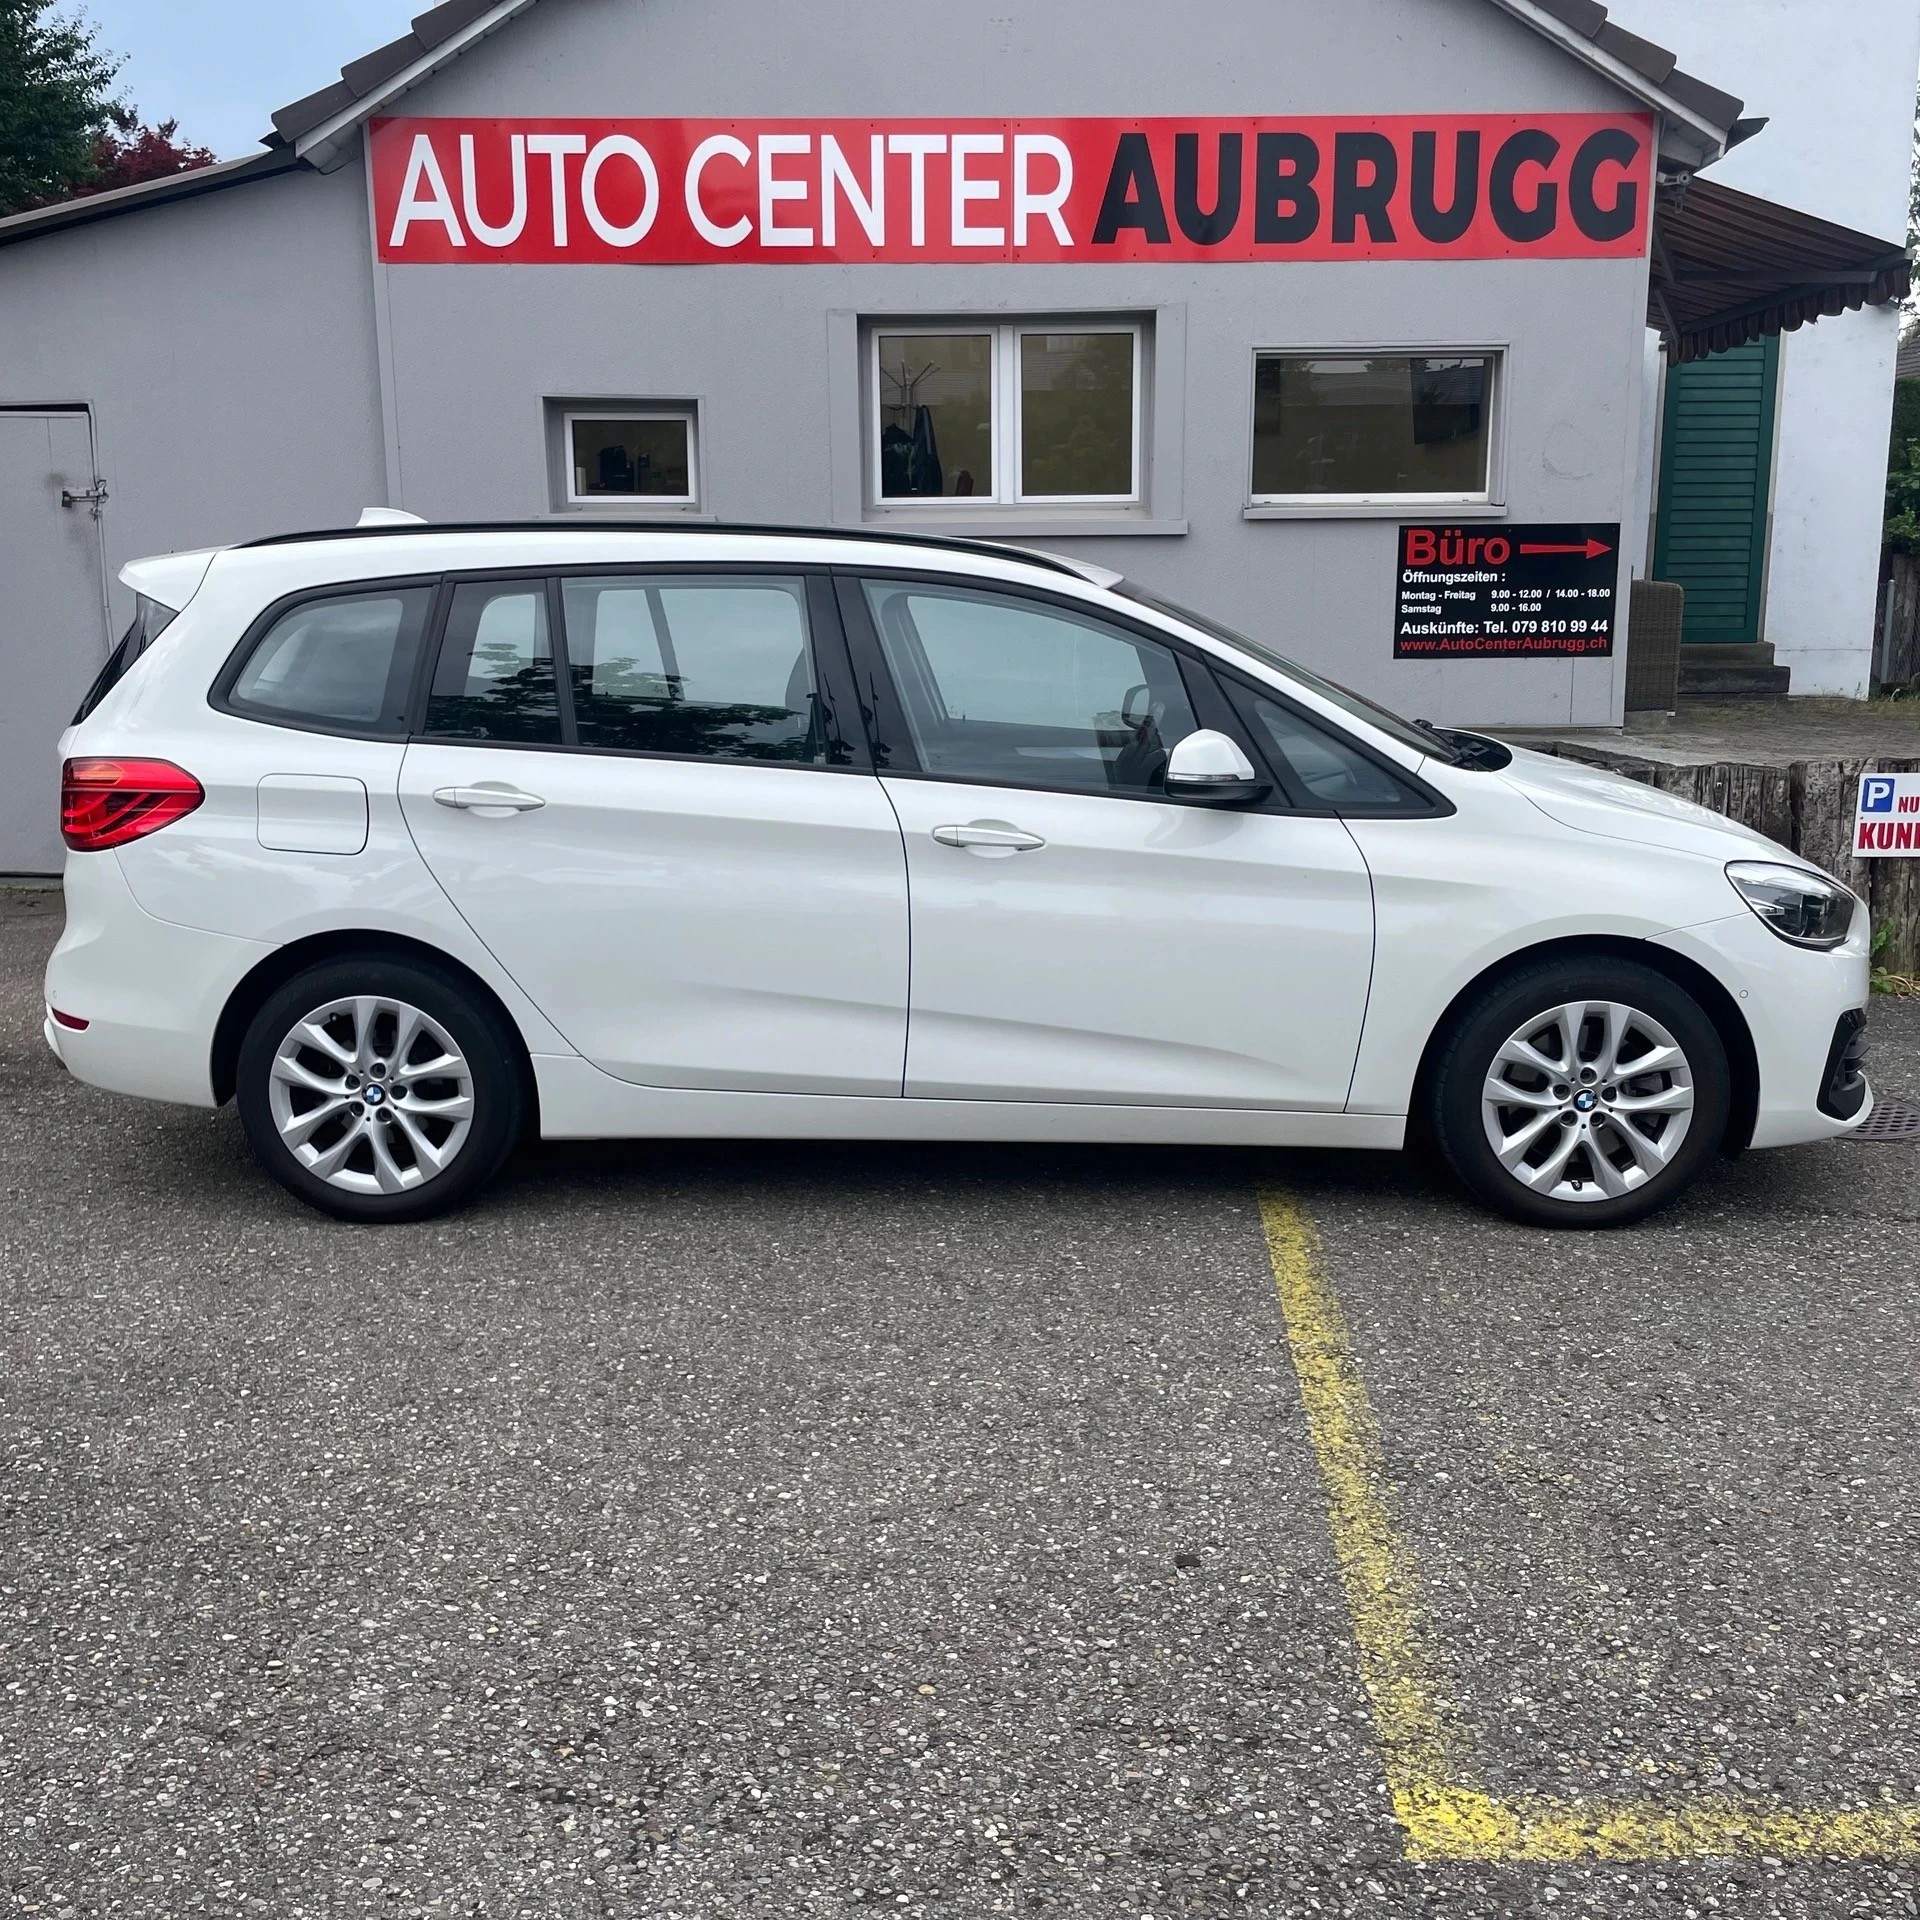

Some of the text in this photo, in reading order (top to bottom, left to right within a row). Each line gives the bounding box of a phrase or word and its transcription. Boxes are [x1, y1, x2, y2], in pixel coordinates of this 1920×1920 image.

[389, 129, 1640, 248] AUTO CENTER AUBRUGG
[1406, 529, 1511, 566] Büro
[1402, 569, 1498, 585] Öffnungszeiten
[1401, 591, 1436, 601] Montag
[1444, 590, 1476, 601] Freitag
[1491, 589, 1510, 598] 9.00
[1519, 589, 1542, 598] 12.00
[1555, 588, 1579, 598] 14.00
[1587, 588, 1611, 598] 18.00
[1401, 604, 1442, 615] Samstag
[1490, 603, 1510, 612] 9.00
[1518, 602, 1541, 612] 16.00
[1400, 619, 1608, 635] Auskünfte: Tel. 079 810 99 44
[1400, 636, 1607, 652] www.AutoCenterAubrugg.ch
[1867, 782, 1890, 808] P
